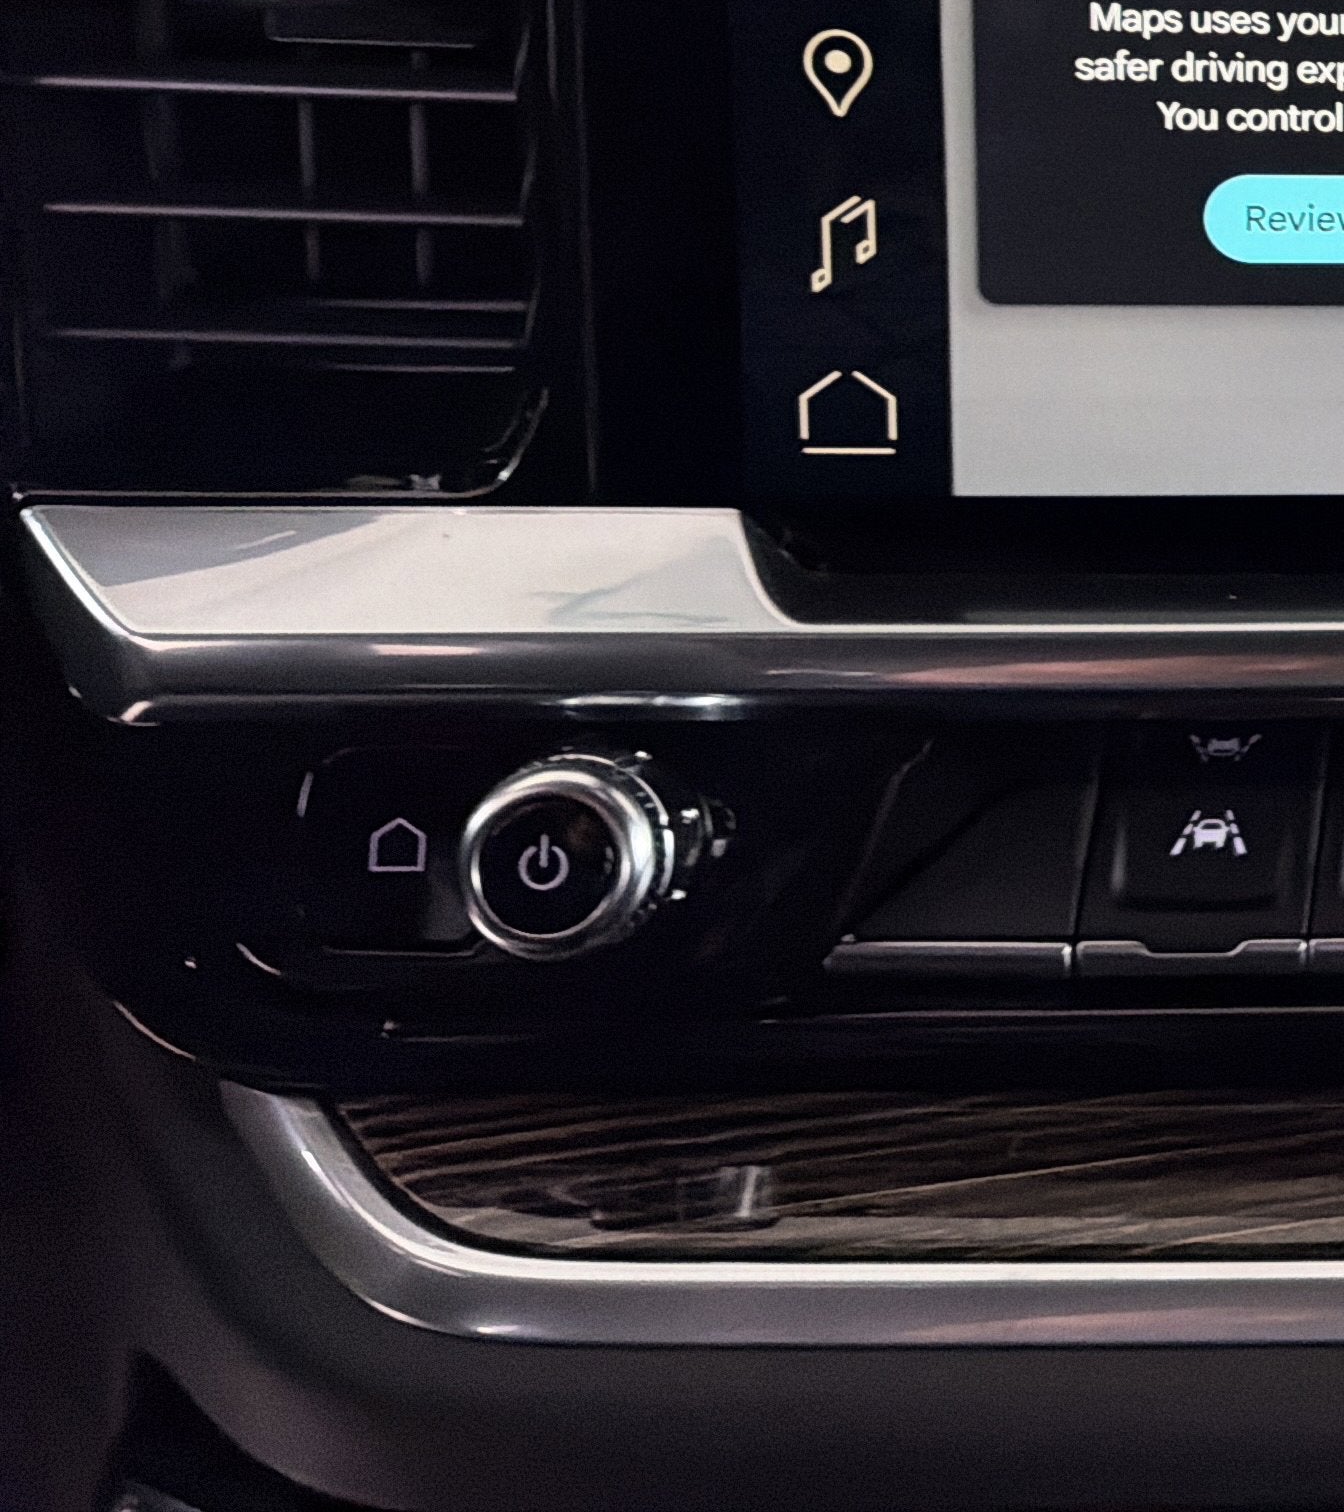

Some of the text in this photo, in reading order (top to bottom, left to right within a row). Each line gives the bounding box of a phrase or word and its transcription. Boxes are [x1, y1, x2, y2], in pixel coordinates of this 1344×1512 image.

[1090, 2, 1183, 39] Maps
[1191, 11, 1270, 34] uses
[1075, 49, 1164, 81] safer
[1171, 51, 1288, 91] driving
[1157, 101, 1218, 131] You
[1226, 102, 1343, 132] control
